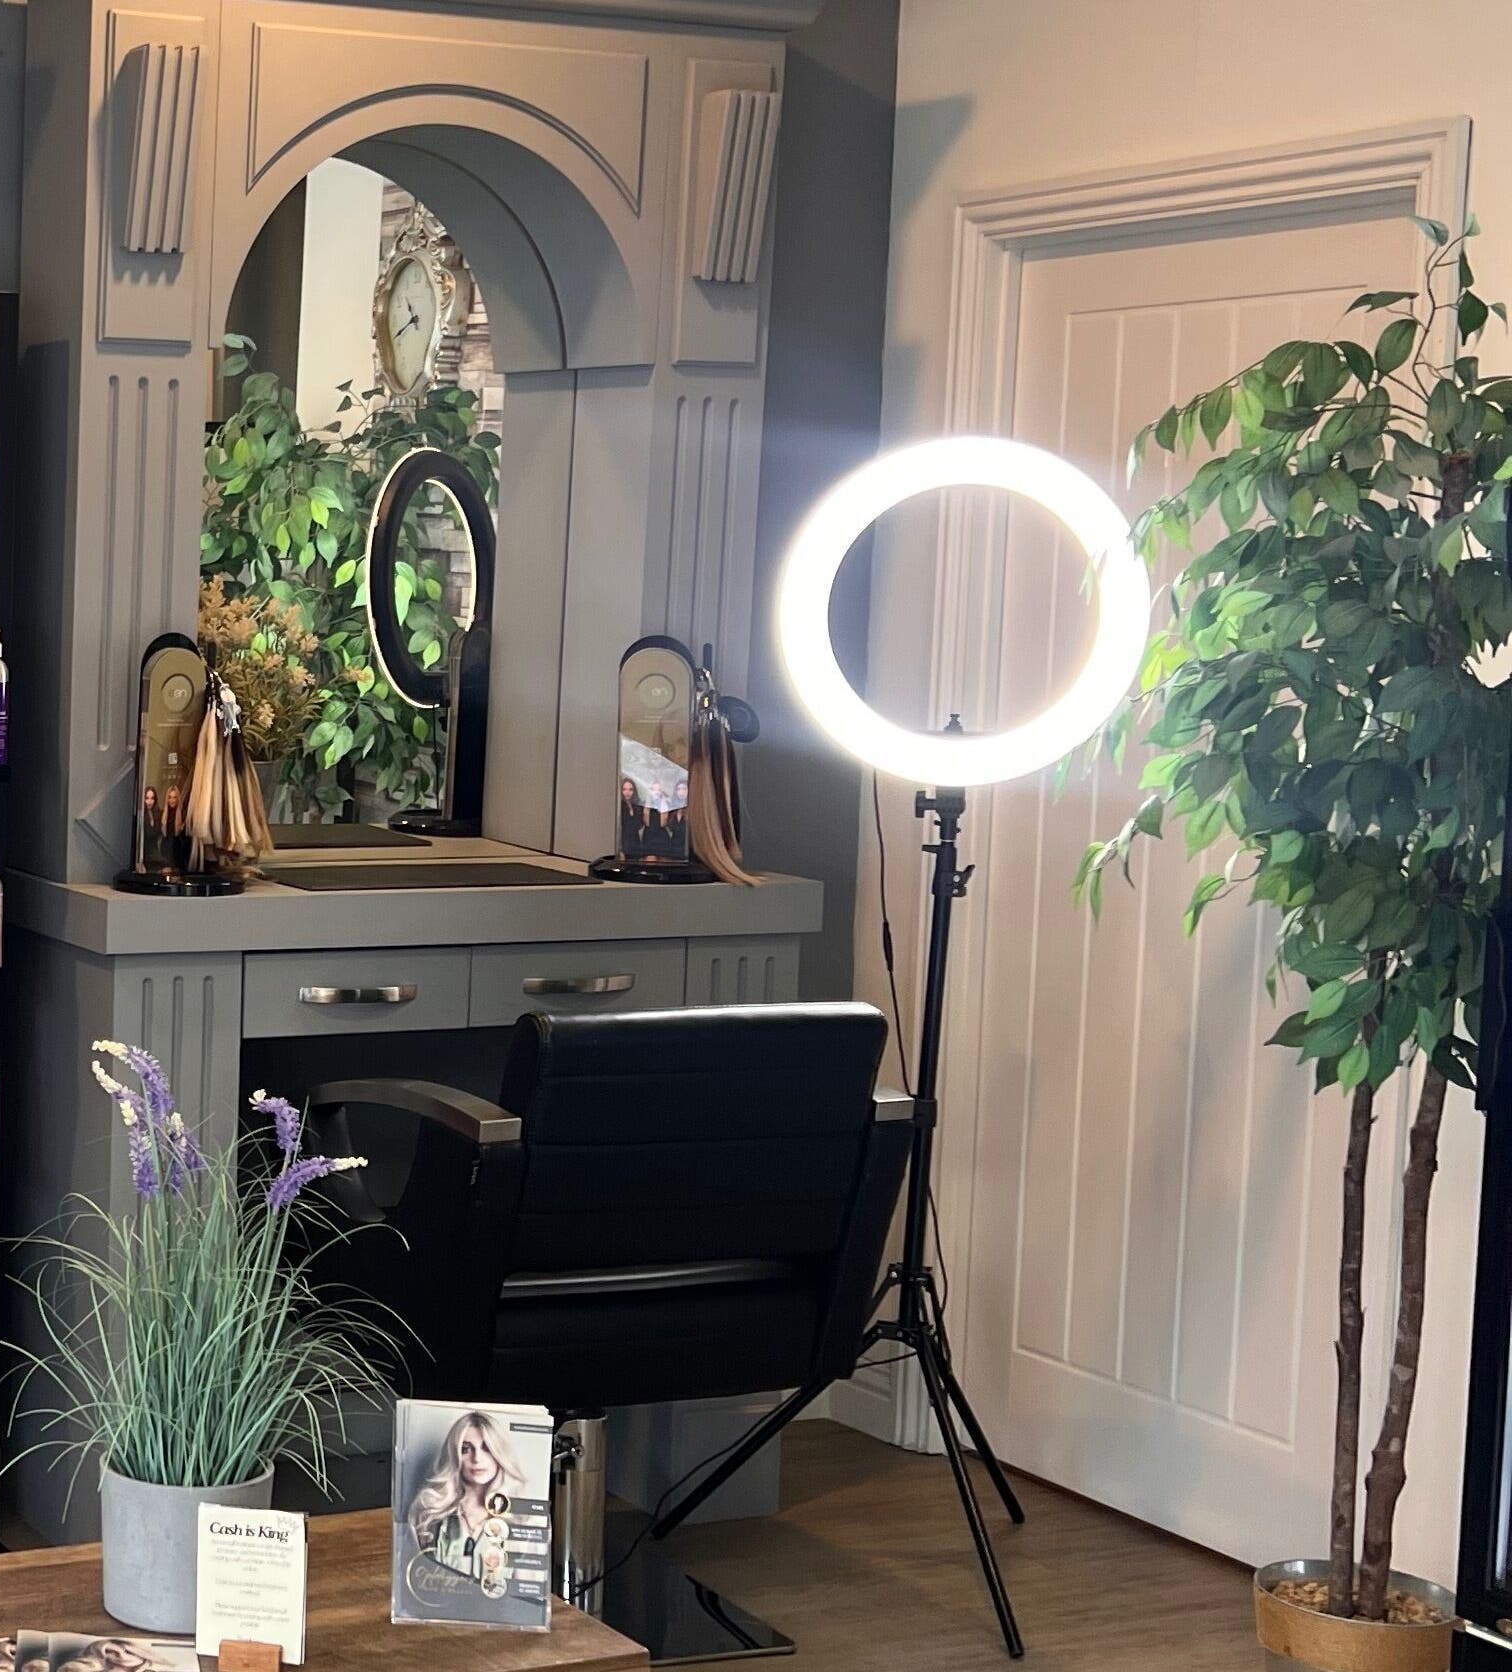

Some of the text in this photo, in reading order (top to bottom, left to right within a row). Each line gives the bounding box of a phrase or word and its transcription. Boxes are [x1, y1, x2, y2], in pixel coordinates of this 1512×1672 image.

[209, 1521, 289, 1543] Cash is King
